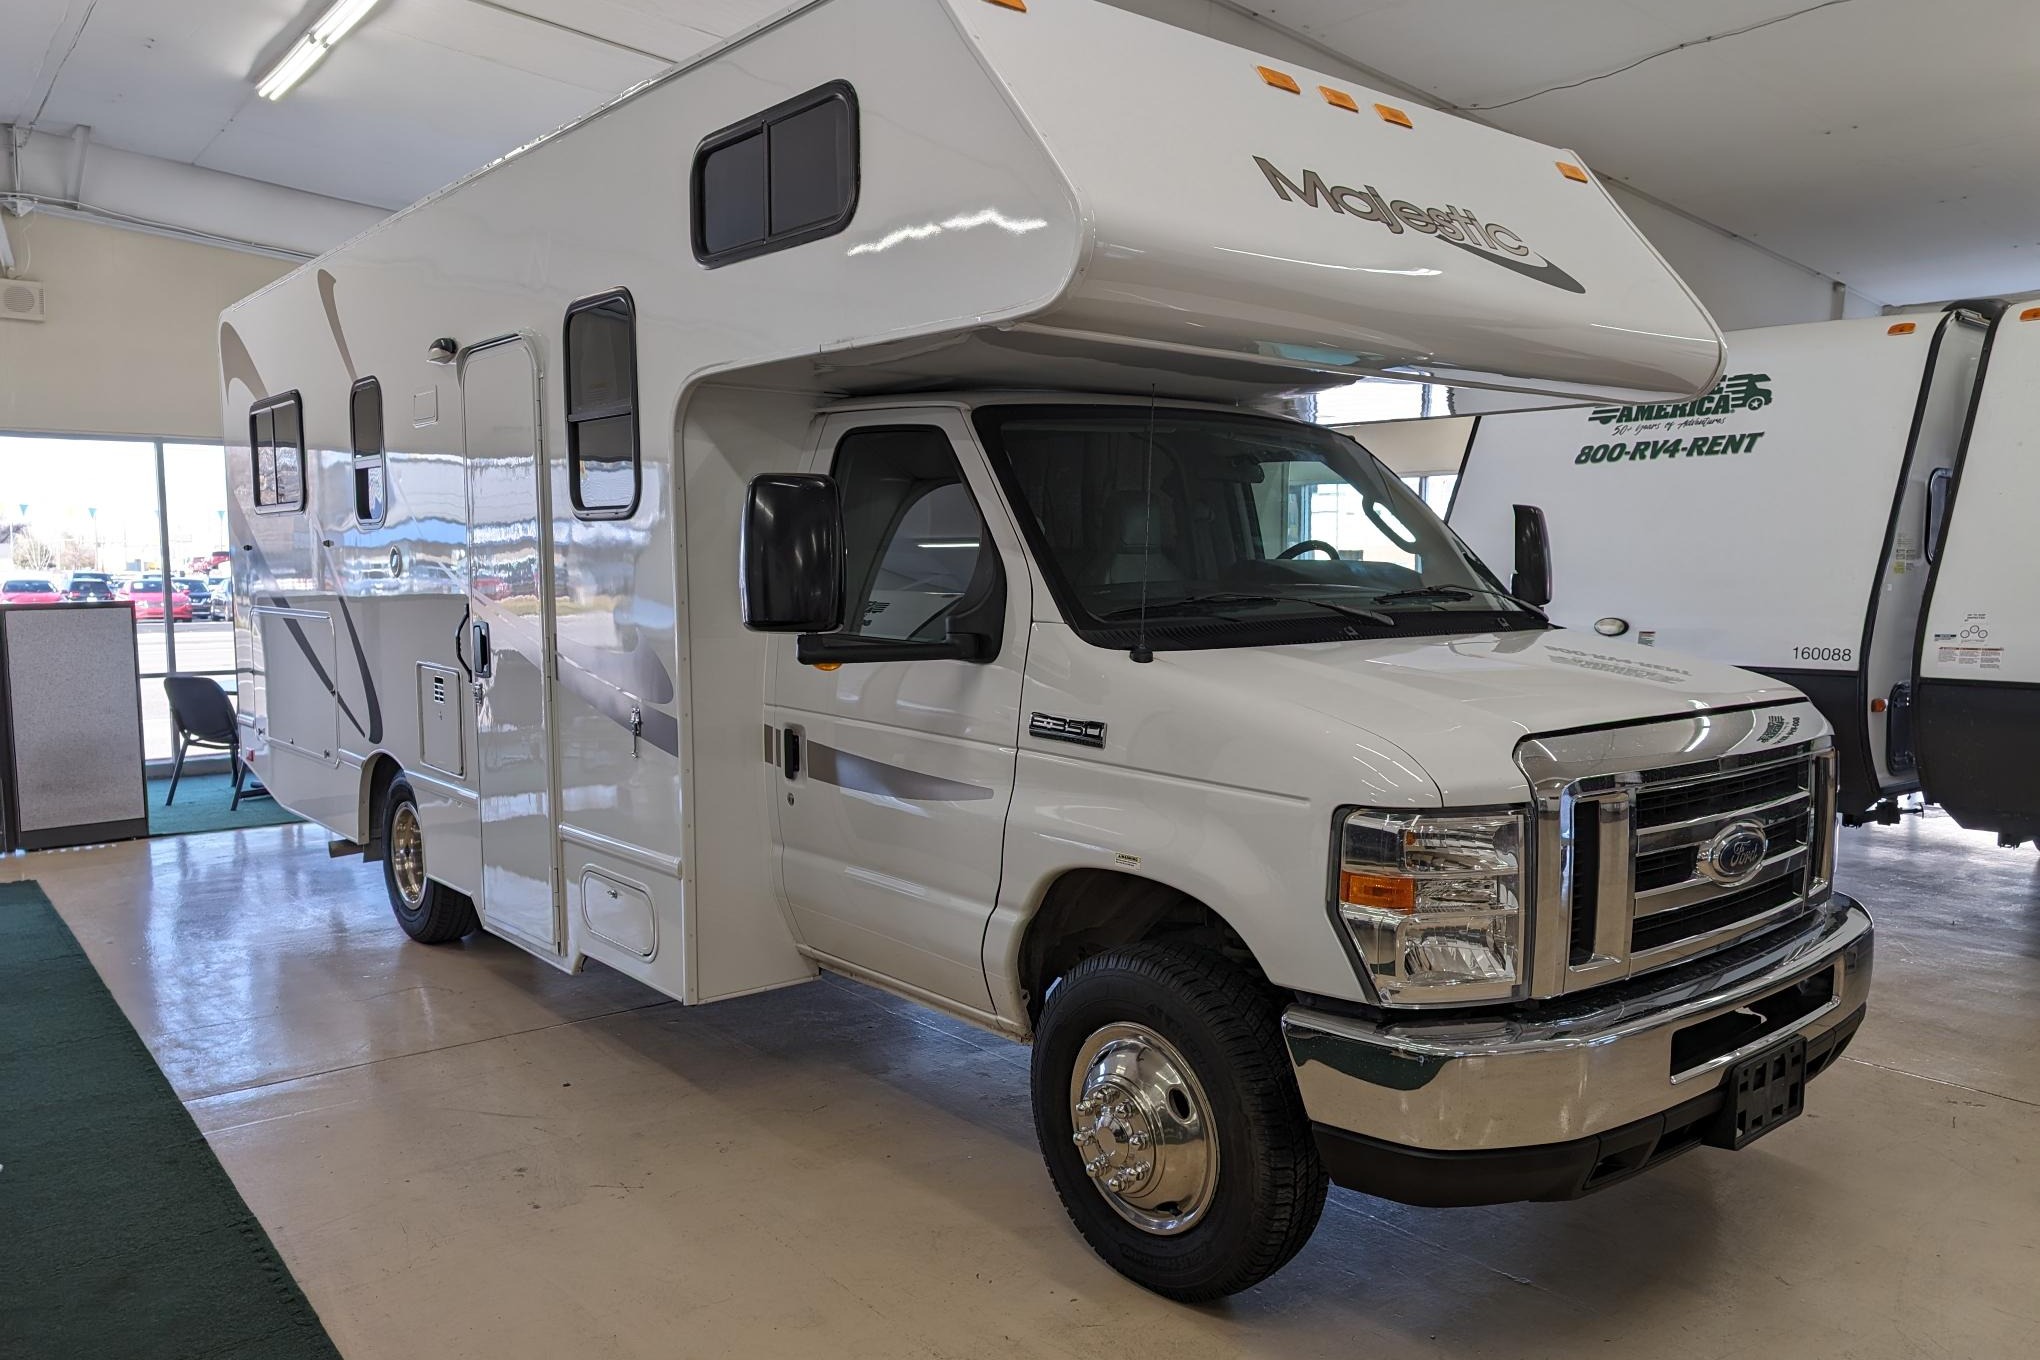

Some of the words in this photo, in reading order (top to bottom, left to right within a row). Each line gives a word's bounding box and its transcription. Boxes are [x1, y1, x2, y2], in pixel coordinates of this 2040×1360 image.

[1252, 155, 1529, 256] Majestic
[1616, 394, 1731, 423] AMERICA
[1574, 431, 1765, 465] 800-RV4-RENT
[1793, 646, 1851, 661] 160088
[1730, 839, 1758, 867] Ford
